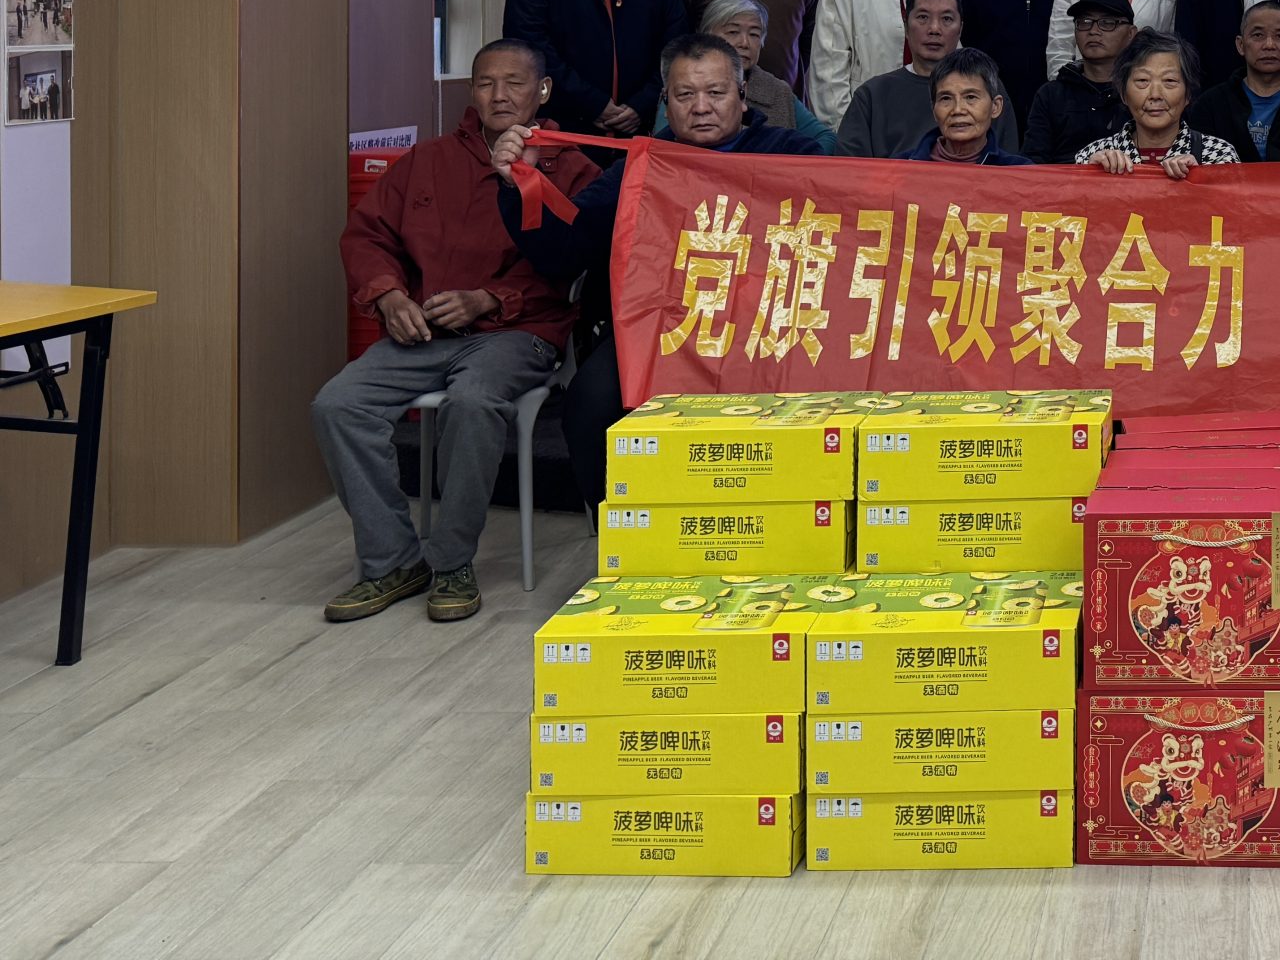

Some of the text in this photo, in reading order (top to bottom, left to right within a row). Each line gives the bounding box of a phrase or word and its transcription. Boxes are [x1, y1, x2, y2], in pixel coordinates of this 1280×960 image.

[660, 193, 1244, 372] 党旗引领聚合力
[688, 442, 764, 462] 菠萝啤味
[939, 439, 1014, 459] 菠萝啤味
[713, 477, 747, 488] 无酒精
[964, 473, 996, 484] 无酒精
[680, 516, 755, 536] 菠萝啤味
[939, 512, 1014, 532] 菠萝啤味
[704, 550, 737, 561] 无酒精
[963, 547, 996, 557] 无酒精
[624, 650, 706, 670] 菠萝啤味
[896, 647, 978, 668] 菠萝啤味
[652, 688, 688, 698] 无酒精
[924, 685, 959, 696] 无酒精
[620, 731, 700, 751] 菠萝啤味
[895, 728, 976, 748] 菠萝啤味
[647, 768, 682, 779] 无酒精
[922, 765, 957, 776] 无酒精
[614, 811, 694, 832] 菠萝啤味
[895, 805, 976, 825] 菠萝啤味
[640, 849, 675, 860] 无酒精
[922, 842, 957, 853] 无酒精
